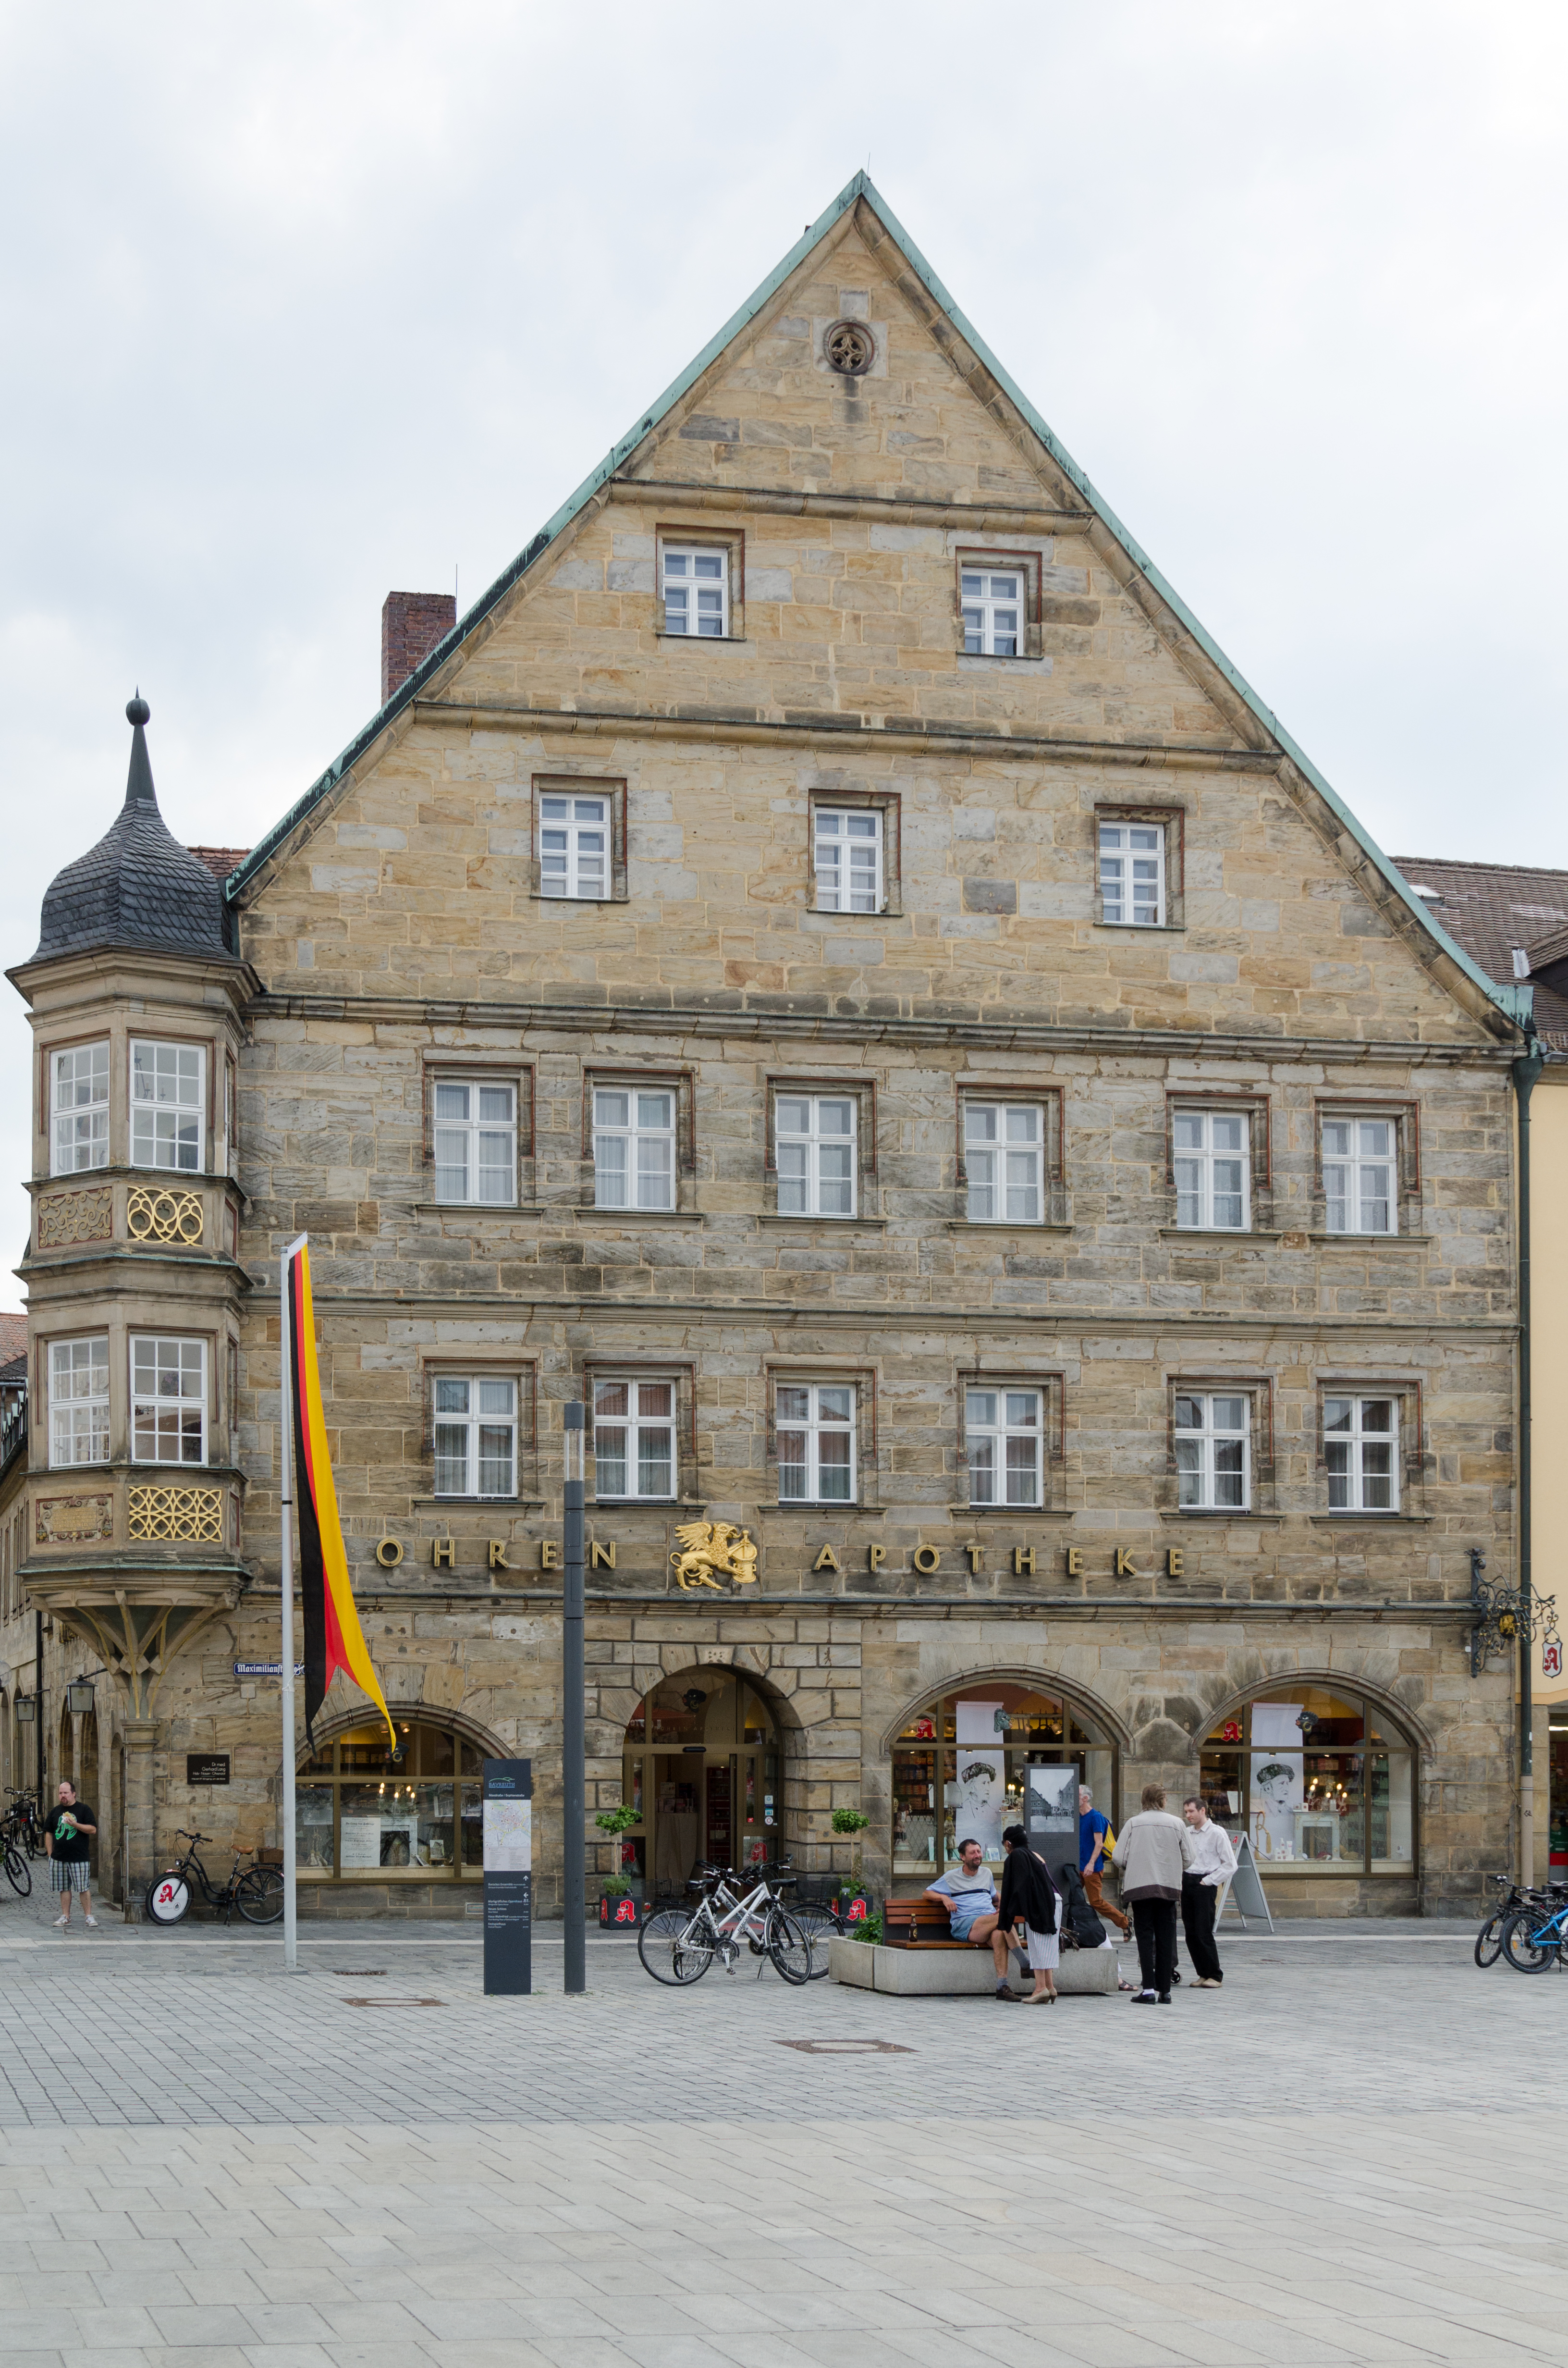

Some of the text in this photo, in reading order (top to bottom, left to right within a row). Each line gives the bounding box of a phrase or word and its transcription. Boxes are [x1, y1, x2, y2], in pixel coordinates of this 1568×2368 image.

[342, 1537, 1185, 1576] OHREN APOTHEKE
[737, 1910, 753, 1932] HERCULES
